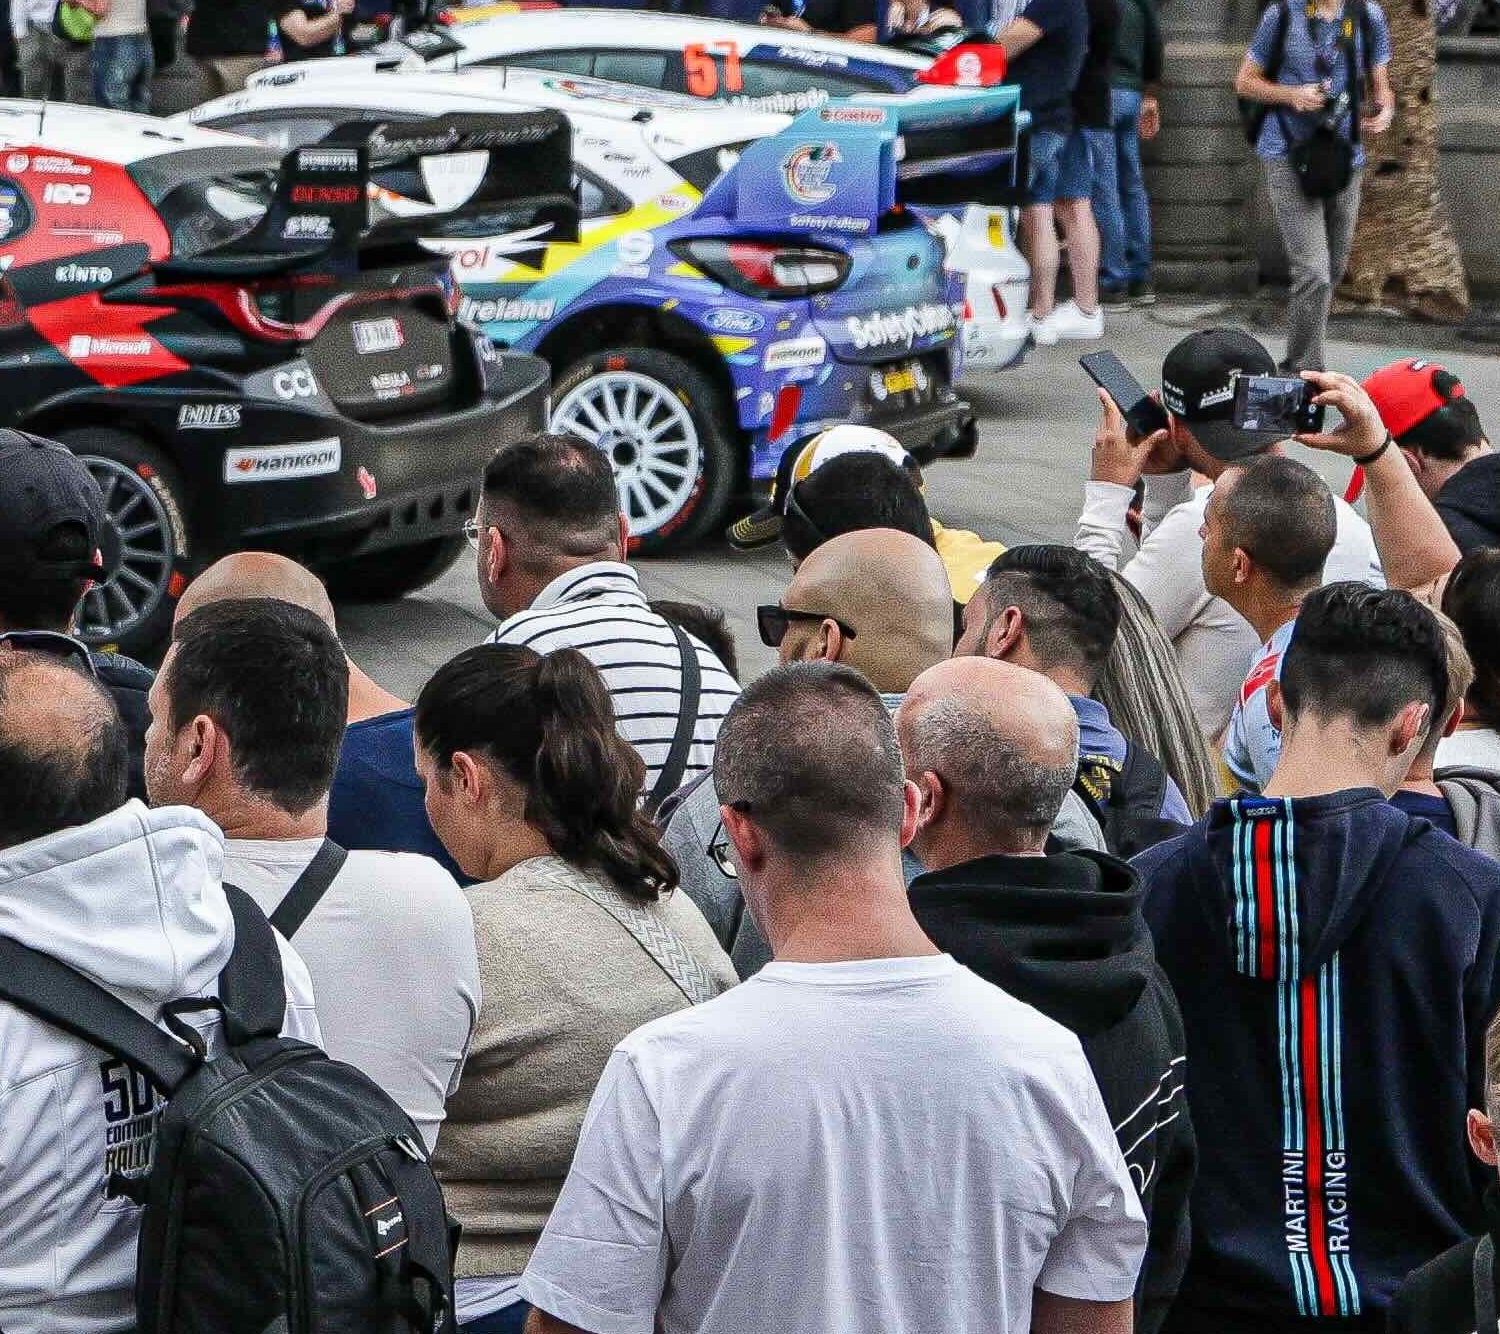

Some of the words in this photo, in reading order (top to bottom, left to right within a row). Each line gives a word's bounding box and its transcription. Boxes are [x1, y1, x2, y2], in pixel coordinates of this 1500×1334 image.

[683, 41, 744, 97] 57
[459, 296, 557, 323] Ireland
[91, 339, 152, 356] Microsoft
[273, 369, 318, 401] CCI
[106, 1121, 154, 1146] EDITION
[104, 1144, 151, 1175] RALLY
[1283, 1149, 1305, 1254] MARTINI
[1326, 1152, 1350, 1254] RACING
